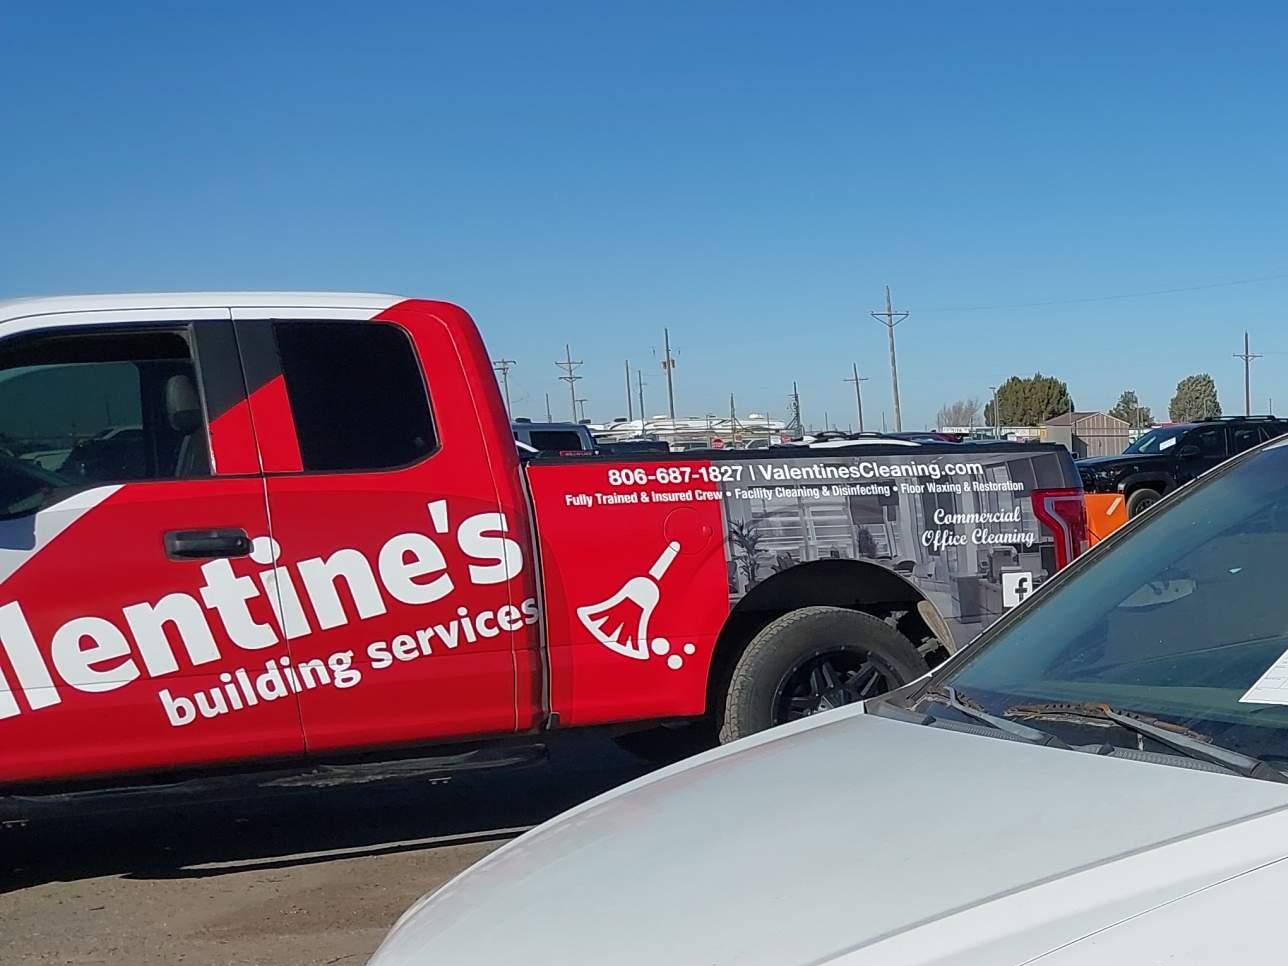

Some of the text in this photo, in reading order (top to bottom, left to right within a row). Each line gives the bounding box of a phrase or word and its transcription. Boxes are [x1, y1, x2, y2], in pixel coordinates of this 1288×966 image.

[608, 465, 743, 486] 806-687-1827
[758, 461, 984, 481] ValentinesCleaning.com
[565, 480, 1024, 507] Fully Trained & Insured Crew Facility Cleaning & Disinfecting Floor Waxing & Restoration
[934, 506, 1022, 525] Commercial
[921, 529, 1036, 551] Office Cleaning
[0, 499, 524, 719] lentine's
[158, 597, 540, 727] building services
